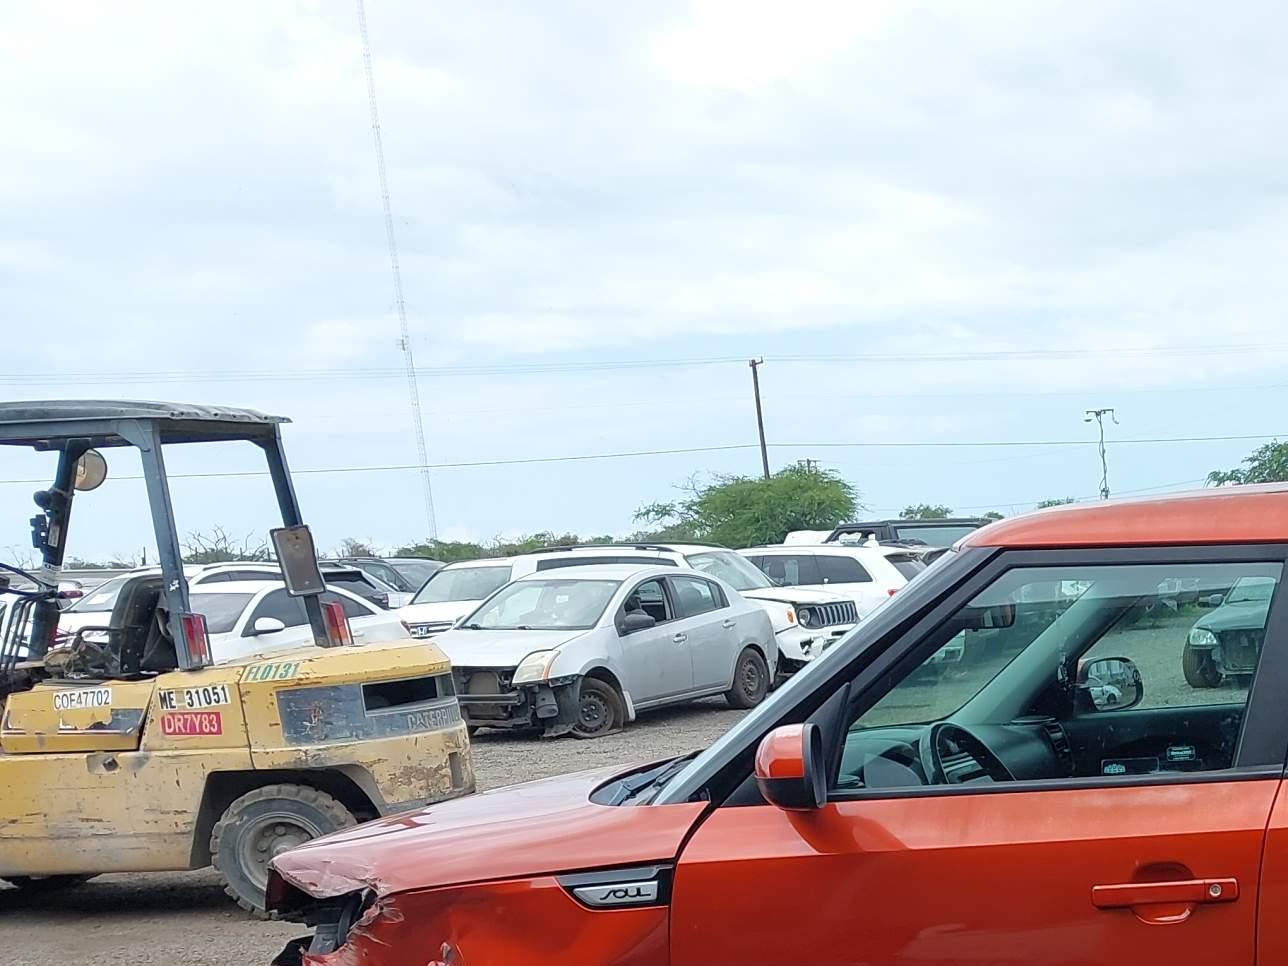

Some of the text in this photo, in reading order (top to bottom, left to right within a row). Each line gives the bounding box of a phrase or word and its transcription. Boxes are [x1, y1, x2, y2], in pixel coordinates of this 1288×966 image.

[159, 685, 228, 709] ME 31051
[164, 714, 218, 733] DR7Y83
